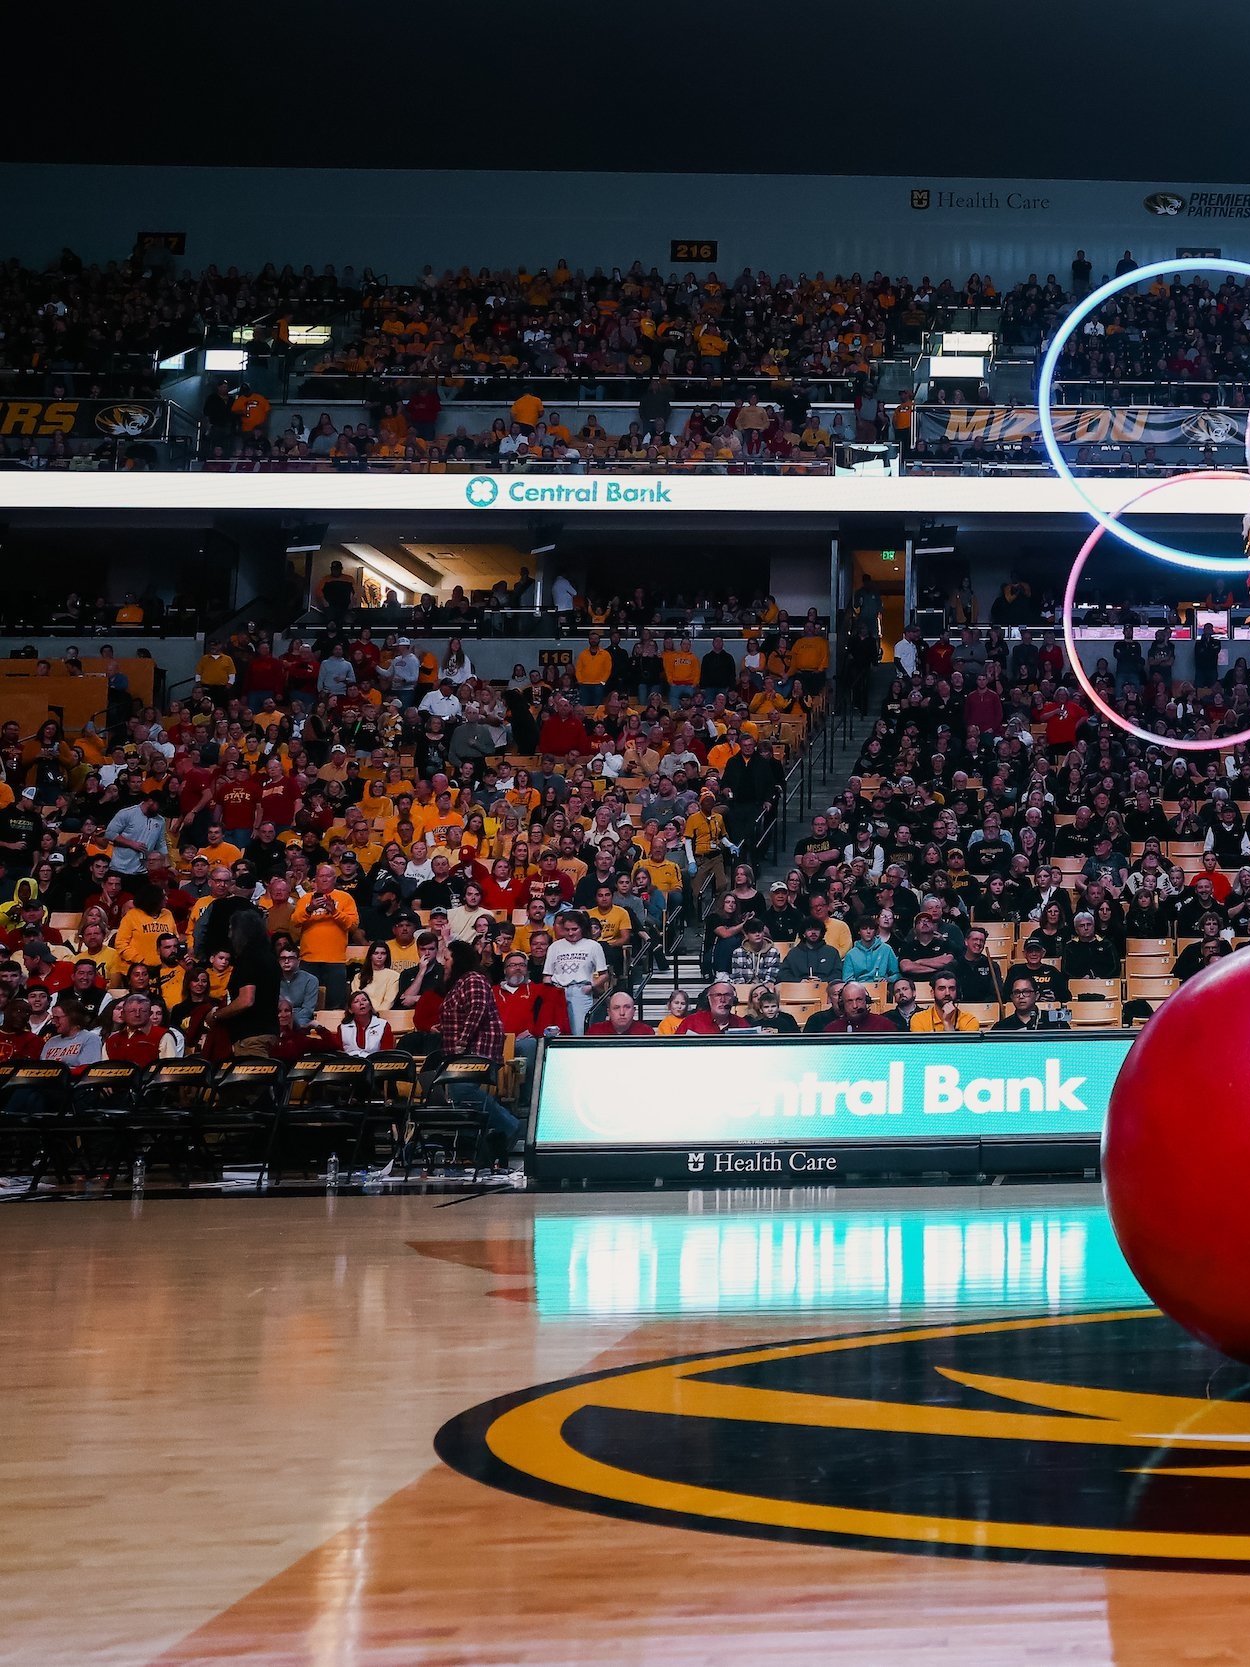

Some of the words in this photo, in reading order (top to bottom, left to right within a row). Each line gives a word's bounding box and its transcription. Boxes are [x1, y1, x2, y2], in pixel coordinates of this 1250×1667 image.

[938, 191, 1000, 209] Health
[1007, 192, 1050, 209] Care
[676, 244, 712, 258] 216
[0, 401, 80, 436] RS
[944, 407, 1149, 442] MIZZOU
[509, 481, 597, 502] Central
[606, 481, 672, 502] Bank
[541, 652, 570, 664] 116
[224, 792, 251, 801] STATE
[142, 922, 169, 933] MIZZOU
[47, 1046, 58, 1058] WE
[60, 1044, 79, 1056] ARE
[16, 1068, 62, 1078] MIZZOU
[87, 1067, 134, 1078] MIZZOU
[160, 1065, 206, 1075] MIZZOU
[233, 1064, 278, 1074] MIZZOU
[322, 1064, 368, 1073] MIZZOU
[446, 1063, 491, 1072] MIZZOU
[745, 1060, 904, 1117] ntral
[924, 1058, 1088, 1113] Bank
[713, 1152, 783, 1173] Health
[788, 1151, 838, 1172] Care
